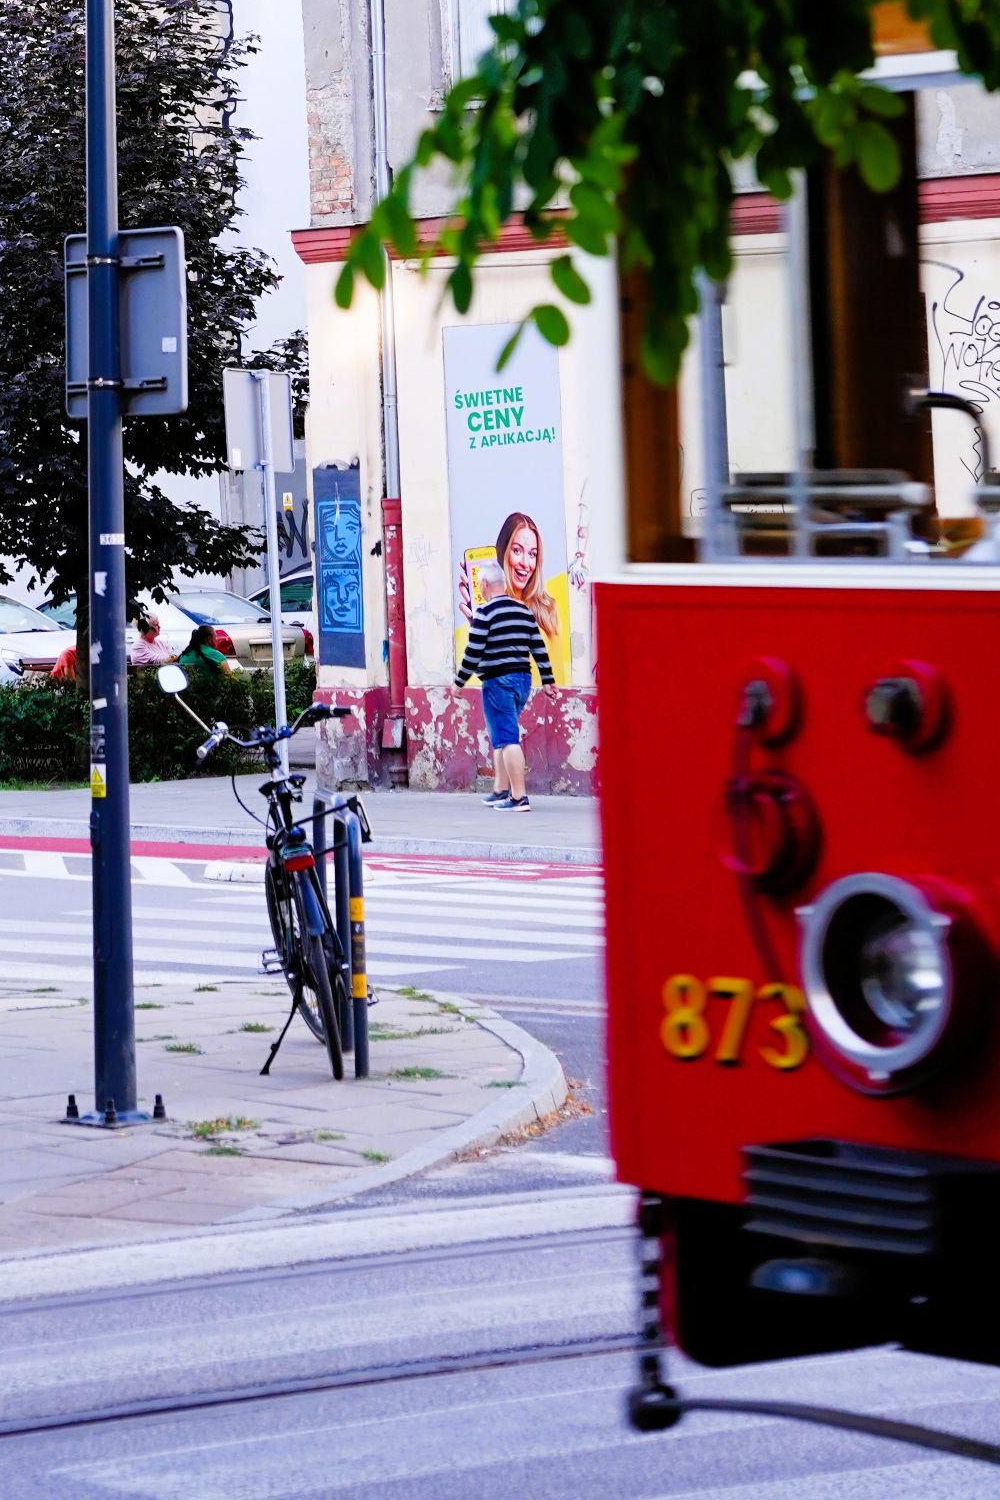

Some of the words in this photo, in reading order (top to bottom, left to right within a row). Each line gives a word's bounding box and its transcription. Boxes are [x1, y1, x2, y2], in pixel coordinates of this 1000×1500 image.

[454, 387, 524, 409] ŚWIETNE
[467, 406, 525, 432] CENY
[469, 437, 477, 449] Z
[481, 427, 556, 448] APLIKACJĄ!
[660, 974, 808, 1070] 873
